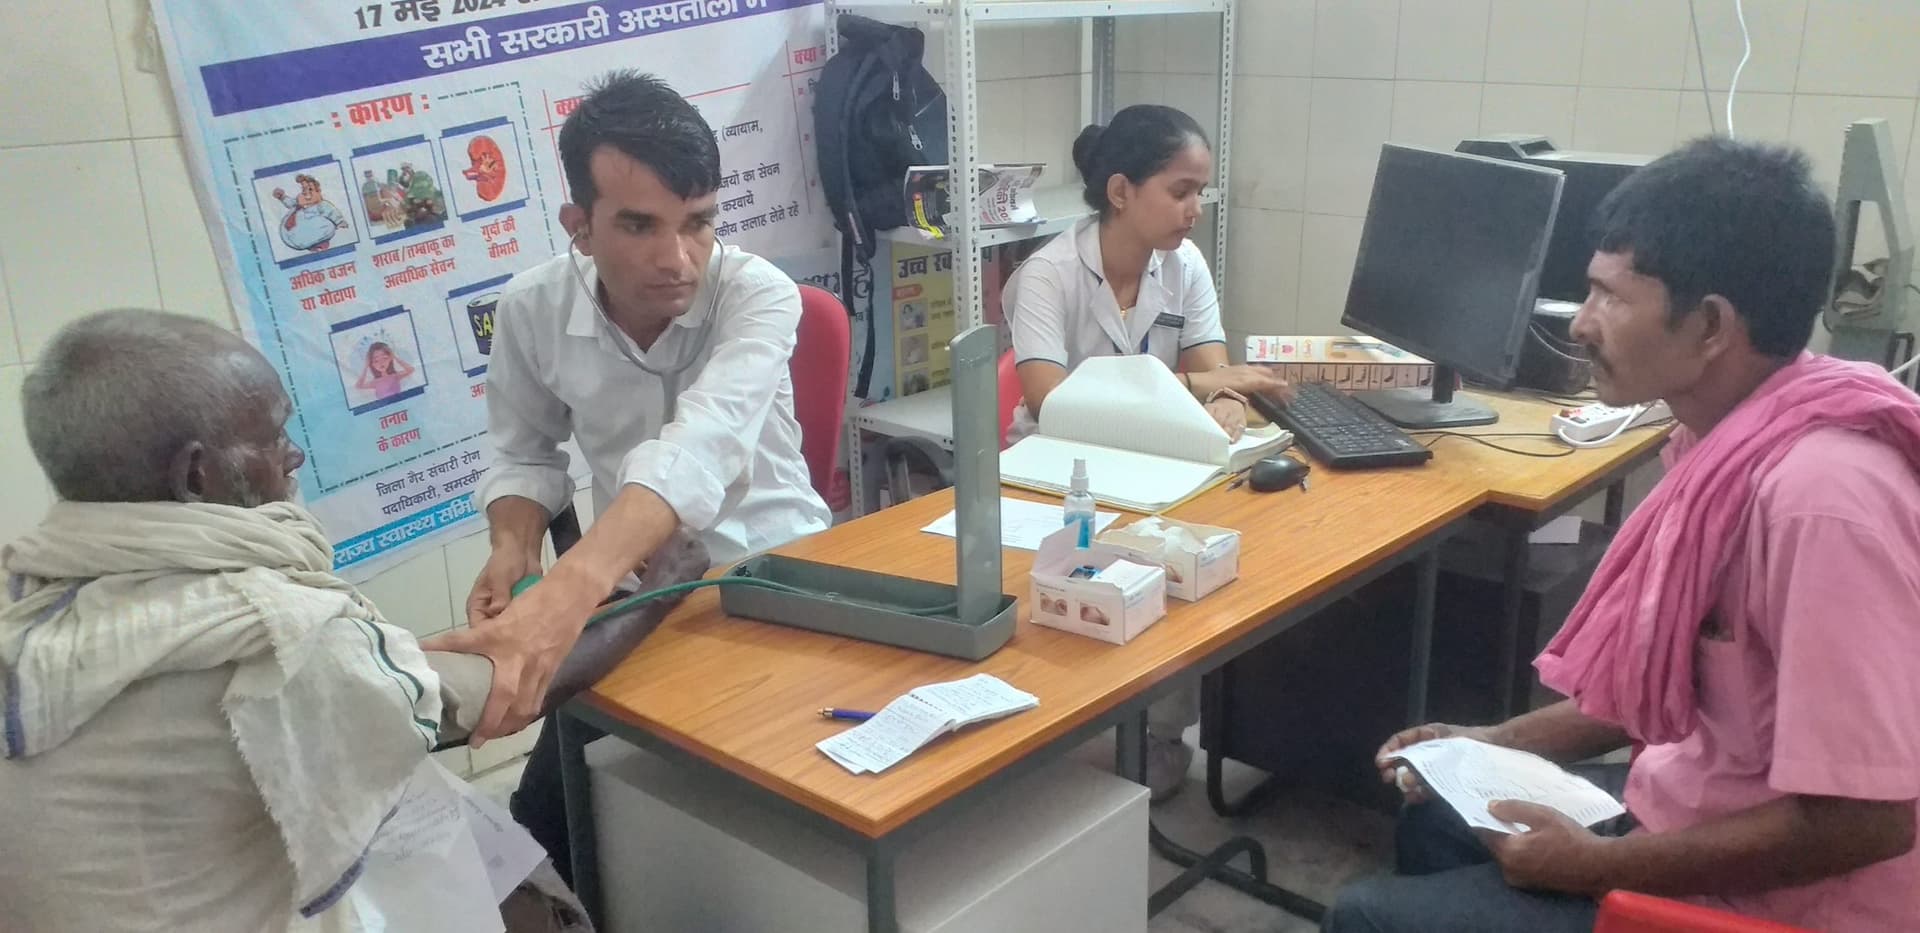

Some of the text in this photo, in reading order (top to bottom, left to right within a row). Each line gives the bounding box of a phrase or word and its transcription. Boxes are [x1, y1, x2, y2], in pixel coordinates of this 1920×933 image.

[354, 4, 382, 30] 17
[452, 0, 506, 14] 20
[420, 26, 492, 69] सभी
[498, 5, 610, 55] सरकारी
[345, 92, 414, 125] कारण
[742, 169, 756, 182] का
[758, 162, 781, 179] सेवन
[501, 215, 516, 233] की
[740, 214, 768, 232] सलाह
[769, 205, 786, 223] लेते
[440, 234, 456, 249] का
[487, 238, 520, 259] बीमारी
[289, 261, 357, 290] अधिक वजन
[384, 258, 456, 289] अत्यधिक सेवन
[897, 255, 929, 279] उच्च
[300, 286, 357, 311] या मोटापा
[379, 409, 408, 430] तनाव
[376, 427, 421, 452] के कारण
[376, 450, 481, 496] जिला गैर संचारी रोग
[382, 467, 490, 515] पदाधिकारी, समस्ती
[376, 513, 436, 548] स्वास्थ्य
[434, 495, 478, 524] समि
